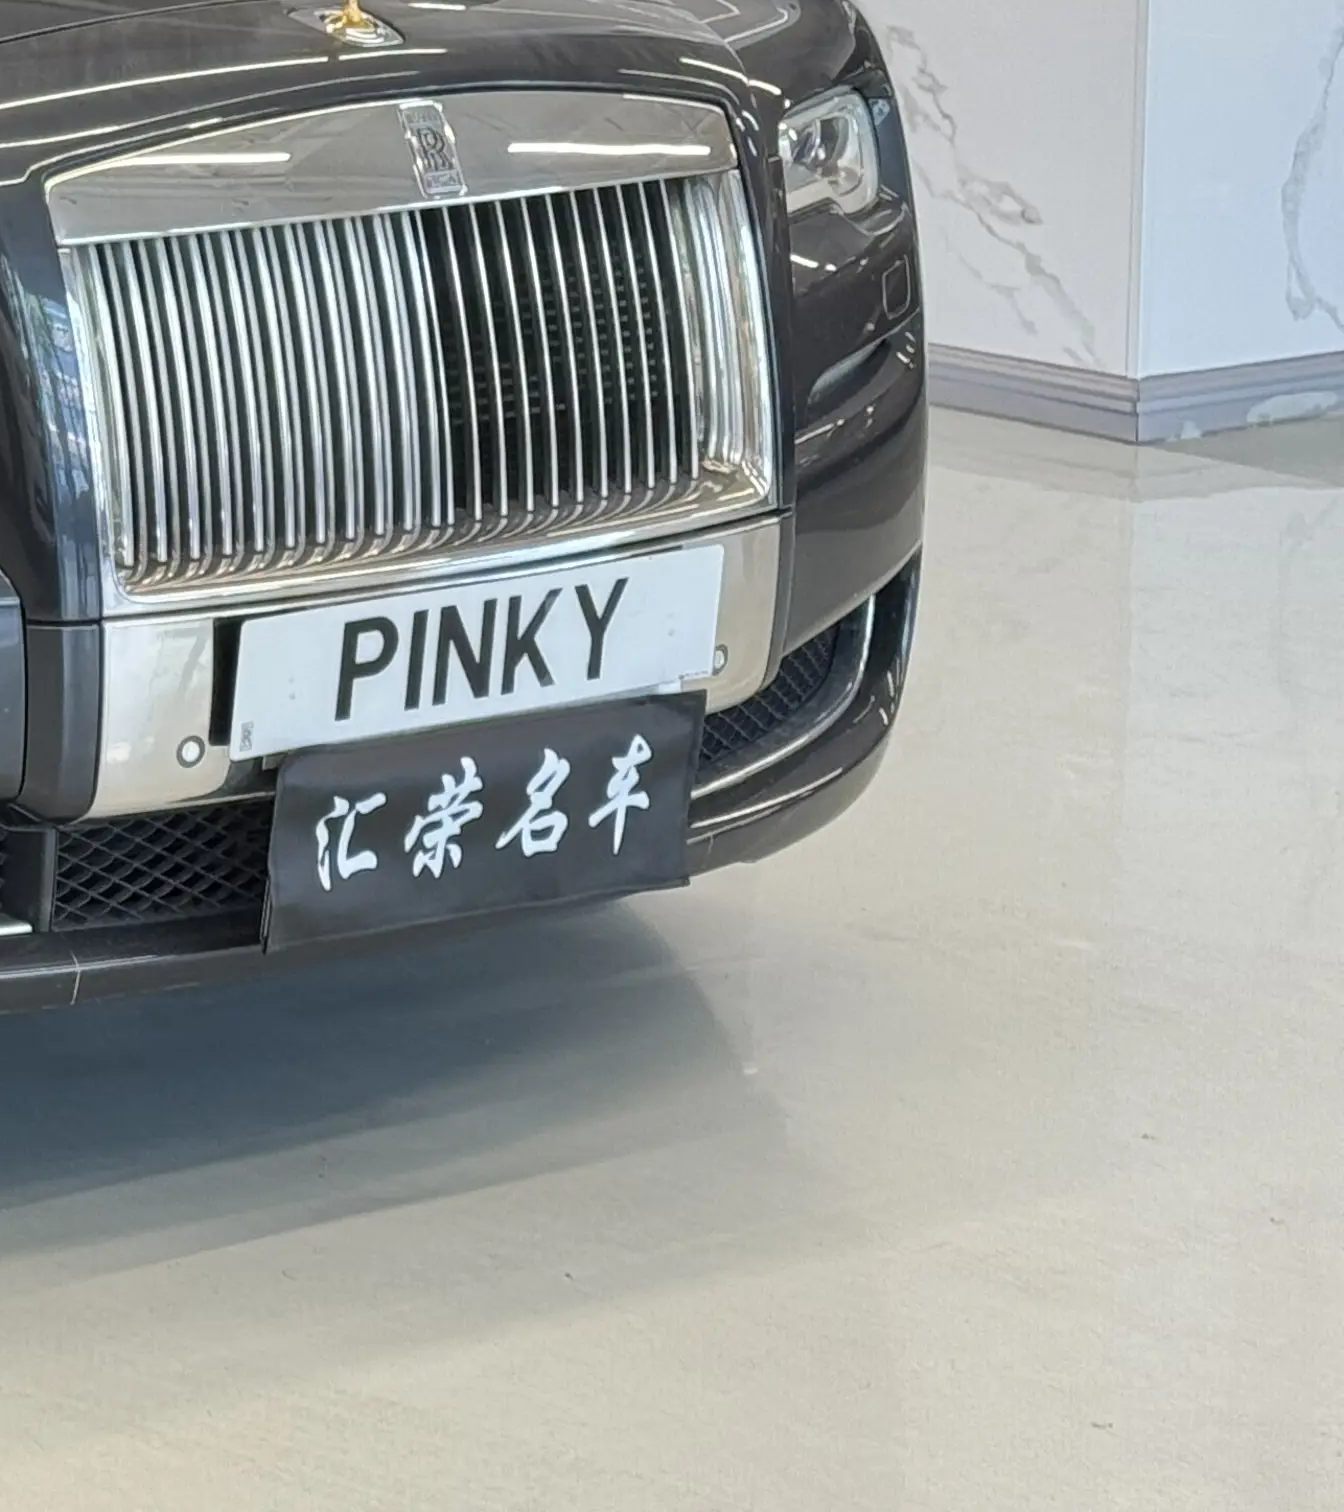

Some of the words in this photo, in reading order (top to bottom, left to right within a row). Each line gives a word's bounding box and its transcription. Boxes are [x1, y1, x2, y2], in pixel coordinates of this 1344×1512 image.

[334, 577, 629, 722] PINKY
[315, 734, 652, 891] 汇荣名车
